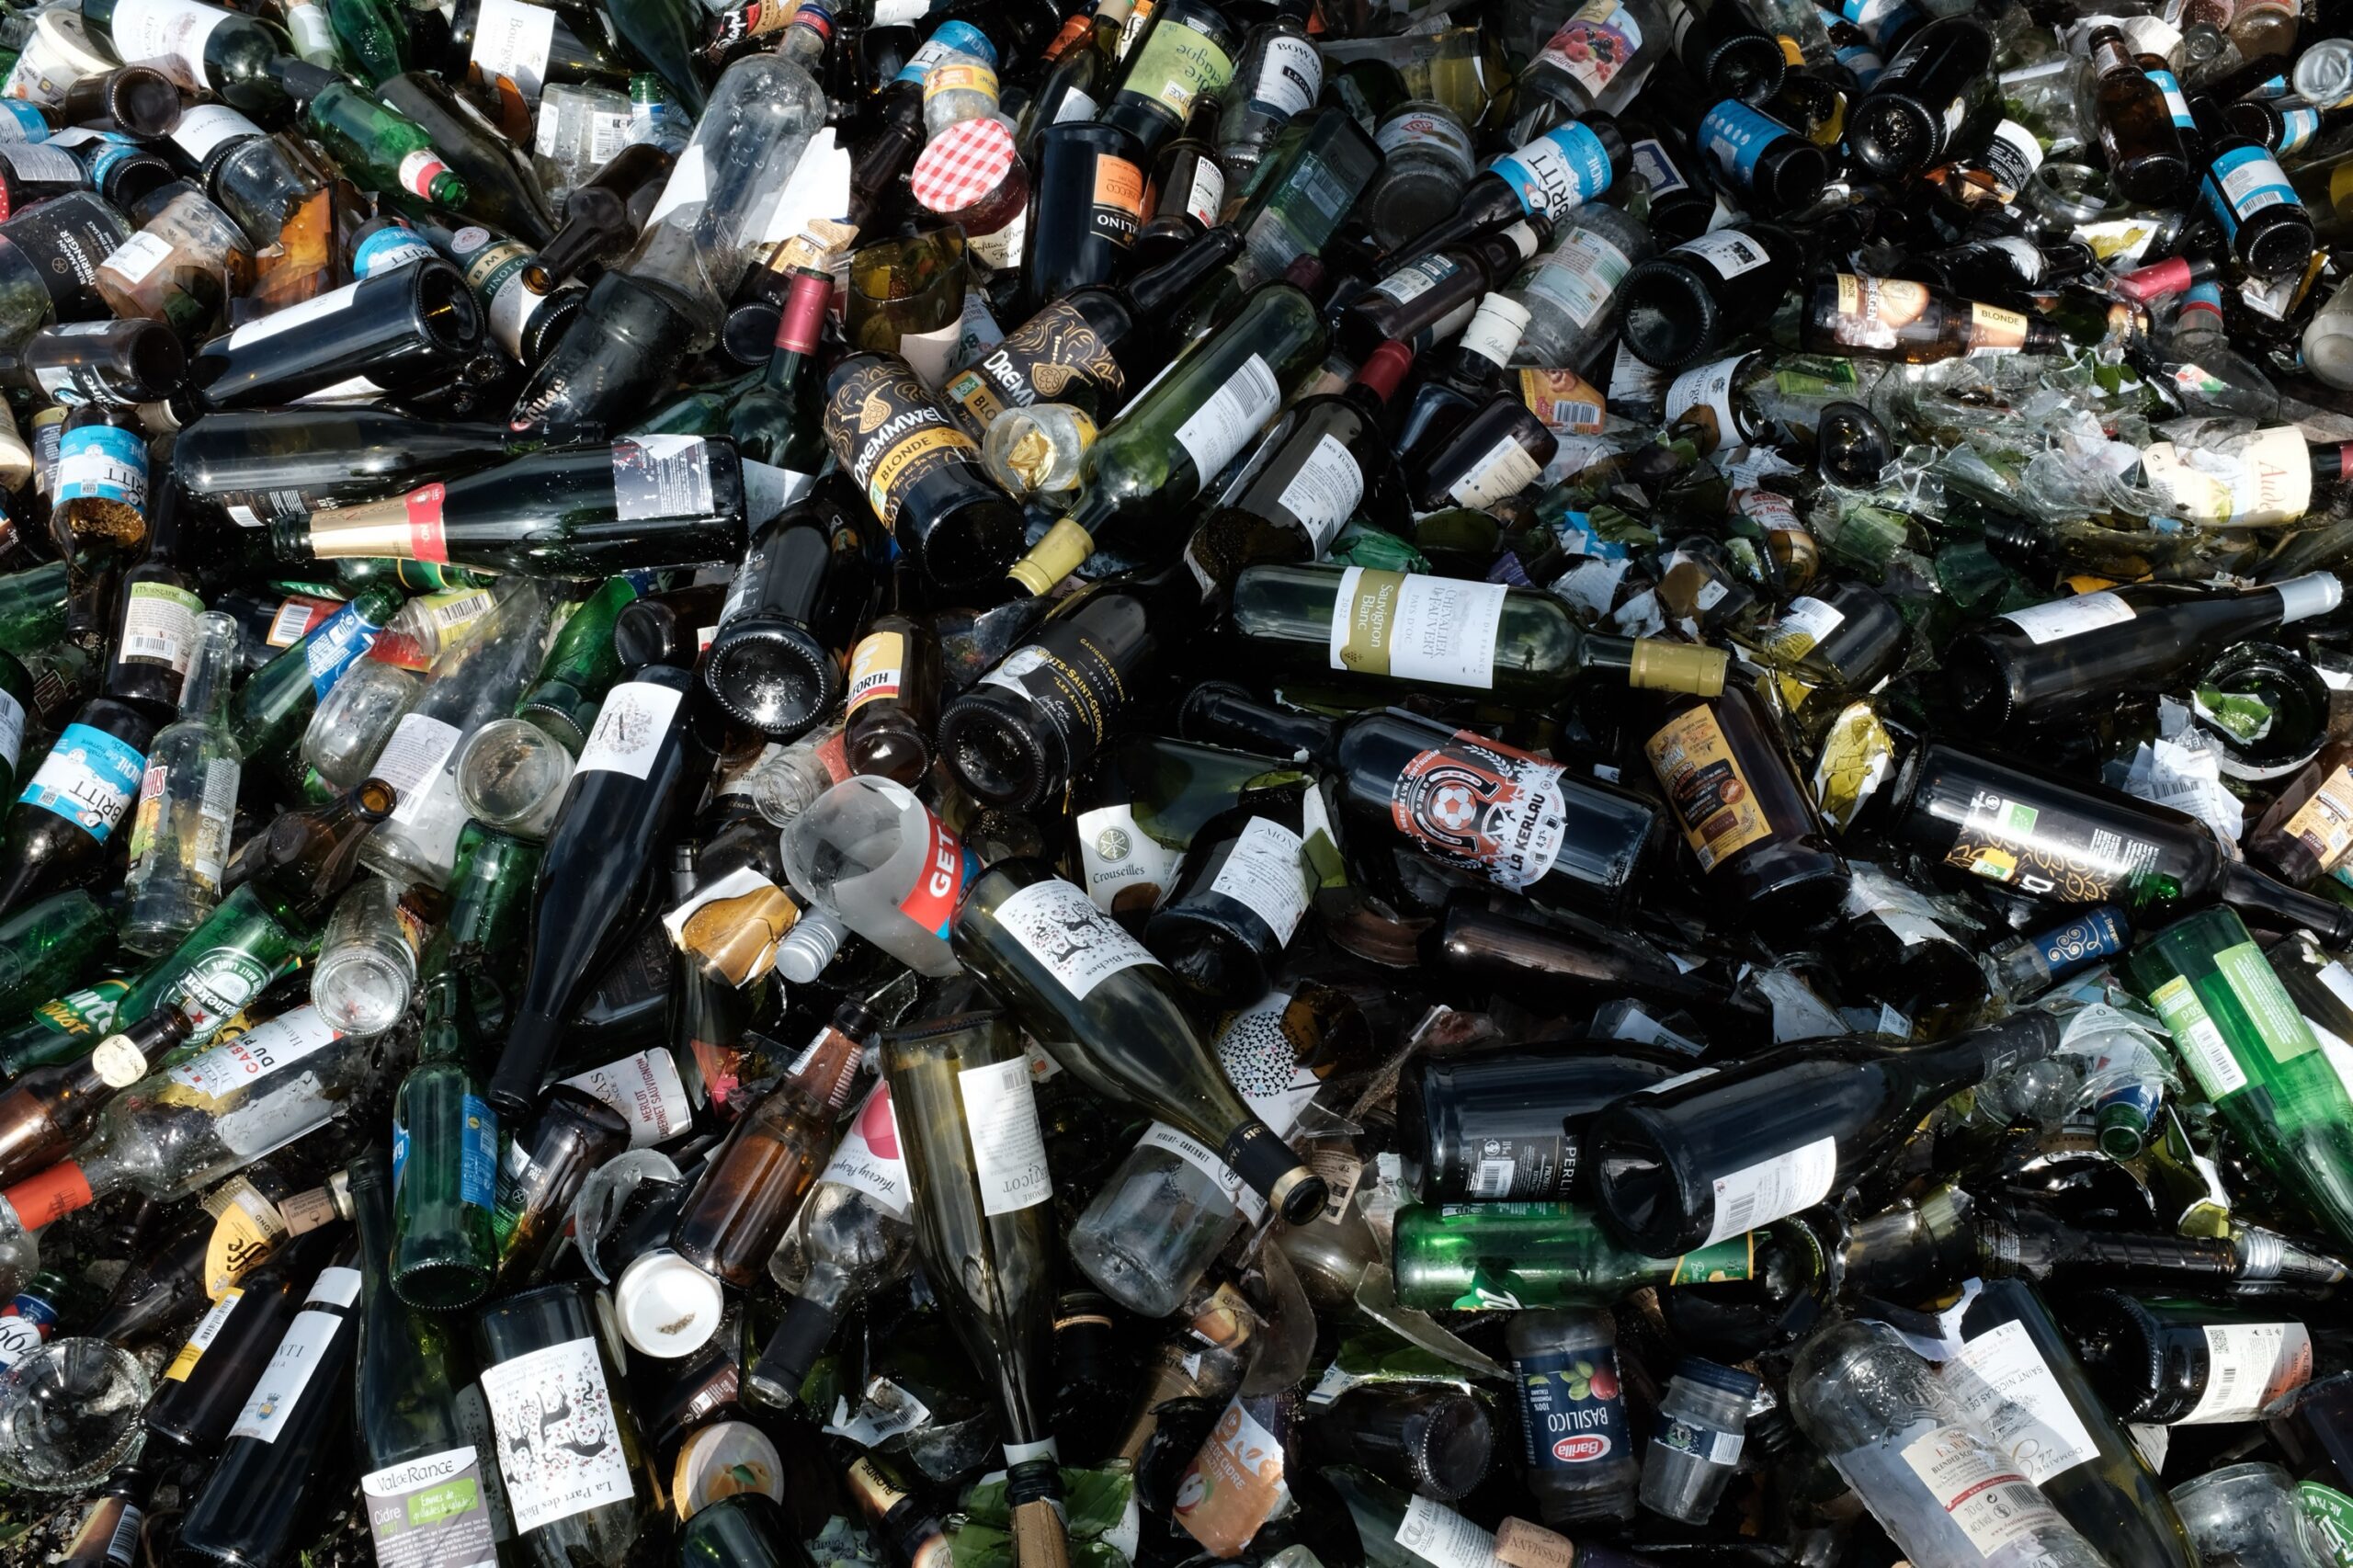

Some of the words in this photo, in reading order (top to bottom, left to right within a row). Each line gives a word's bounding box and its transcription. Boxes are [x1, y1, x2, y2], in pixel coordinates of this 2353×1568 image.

[500, 17, 524, 74] Bourgog
[1404, 119, 1435, 133] TOP
[1527, 154, 1571, 221] BRITT
[1097, 213, 1140, 234] RLINO
[56, 238, 87, 286] RUHLMANN
[59, 228, 97, 287] DIRRINGER
[485, 264, 514, 296] PINOT
[1981, 309, 2020, 326] BLONDE
[984, 349, 1035, 410] DREMM
[881, 436, 932, 483] BLONDE
[2256, 460, 2290, 511] Aude
[1358, 595, 1375, 631] Blanc
[1370, 583, 1394, 649] Sauvignon
[847, 671, 890, 705] LFORTH
[1087, 669, 1106, 692] 2017
[68, 778, 123, 825] BRITT
[1515, 791, 1547, 852] KERLAU
[929, 824, 956, 898] GET
[1092, 862, 1145, 886] Crouseilles
[1508, 852, 1523, 871] LA
[210, 960, 238, 971] LAGER
[238, 964, 259, 983] MALT
[1086, 949, 1124, 978] Biches
[253, 1046, 276, 1069] DU
[640, 1057, 662, 1096] SAUVIGNON
[634, 1090, 654, 1123] MERLOT
[653, 1096, 671, 1141] CABERNET
[856, 1165, 895, 1195] Thierry
[1003, 1167, 1051, 1194] ERTICOT
[1563, 1145, 1578, 1195] PERLI
[2014, 1362, 2044, 1386] SAINT
[1976, 1376, 2017, 1406] NICOLAS
[1533, 1402, 1551, 1412] 100%
[1548, 1406, 1609, 1432] BASILICO
[1557, 1439, 1600, 1460] Barilla
[2032, 1444, 2084, 1473] DOMAINE
[1220, 1456, 1246, 1490] CIDRE
[1930, 1456, 1959, 1474] BLENDED
[373, 1506, 402, 1527] Cidre
[379, 1522, 399, 1538] BRUT
